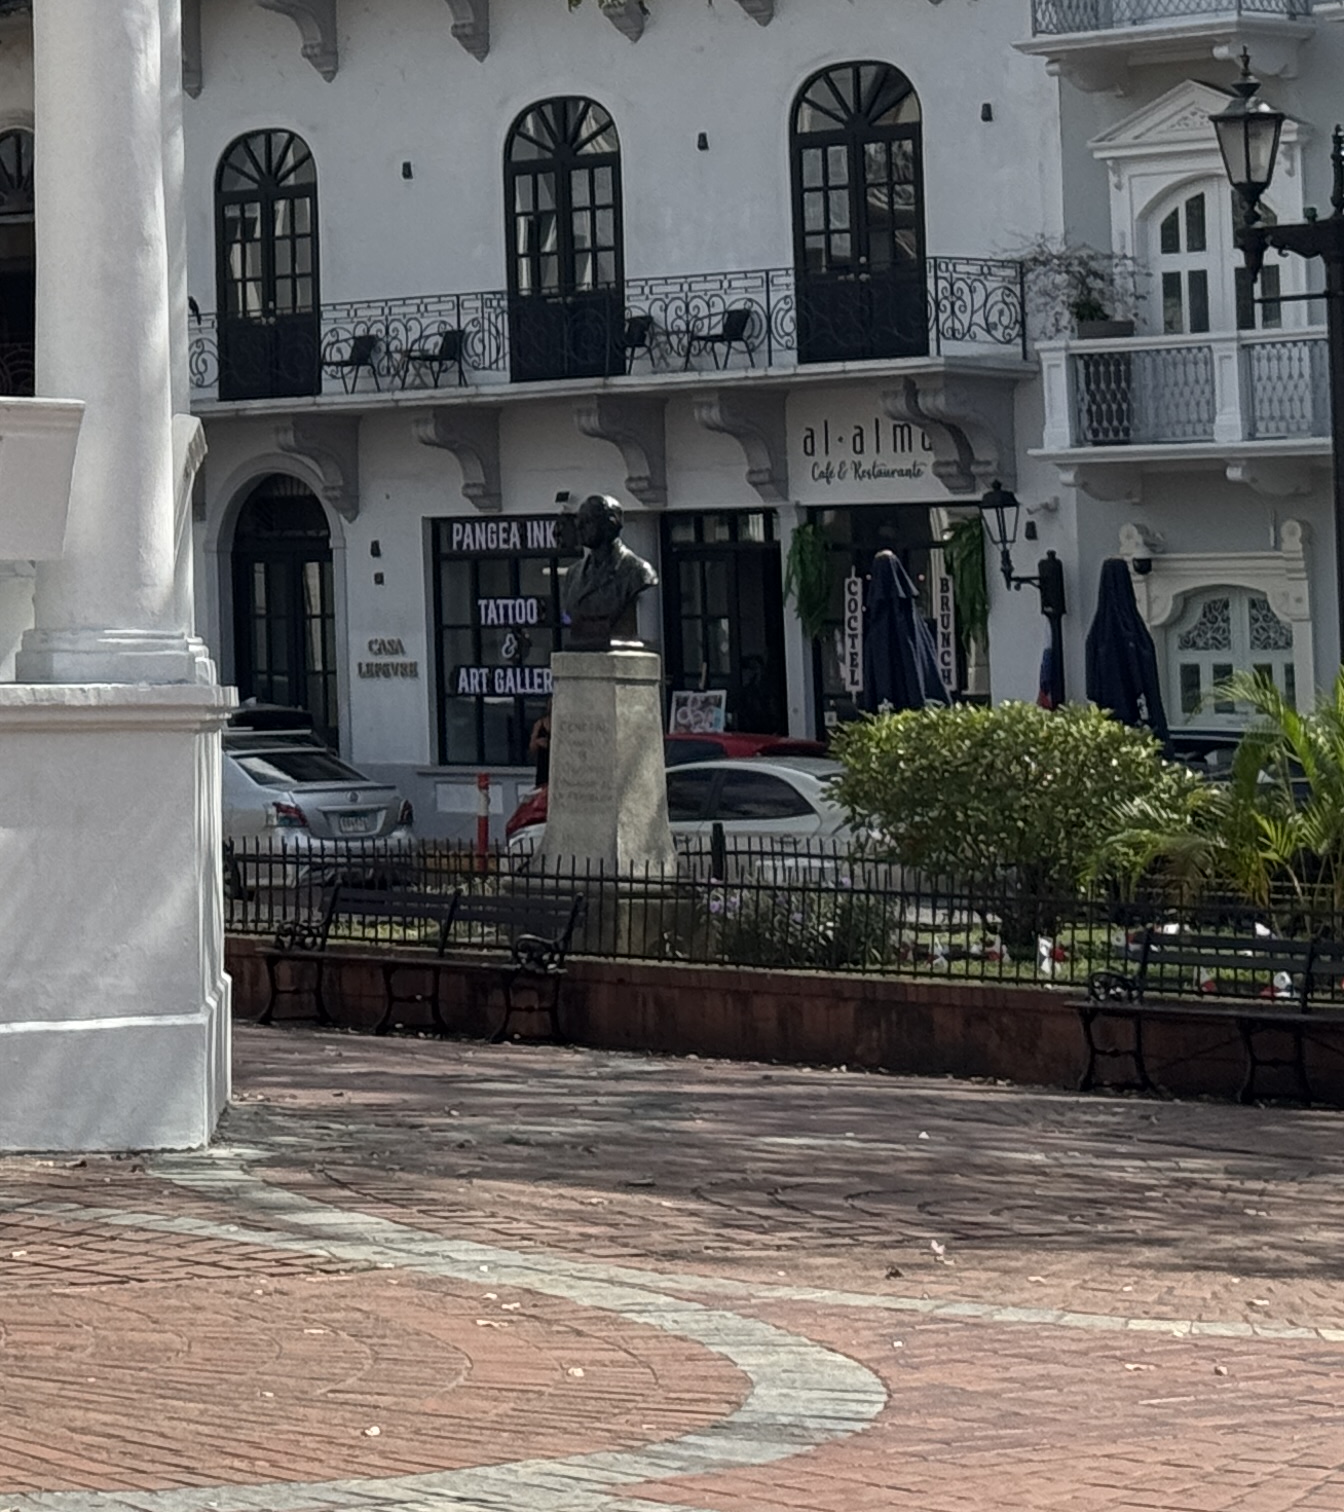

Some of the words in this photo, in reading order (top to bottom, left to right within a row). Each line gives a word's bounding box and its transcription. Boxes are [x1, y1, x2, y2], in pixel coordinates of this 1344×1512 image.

[837, 460, 848, 480] &
[850, 459, 928, 481] Restaurante
[452, 521, 521, 551] PANGEA
[526, 520, 558, 550] INK
[478, 598, 538, 625] TATTOO
[847, 579, 859, 686] COCTEL
[940, 577, 952, 686] BRUNCH
[368, 638, 406, 657] CASA
[457, 667, 489, 694] ART
[494, 667, 553, 695] GALLER
